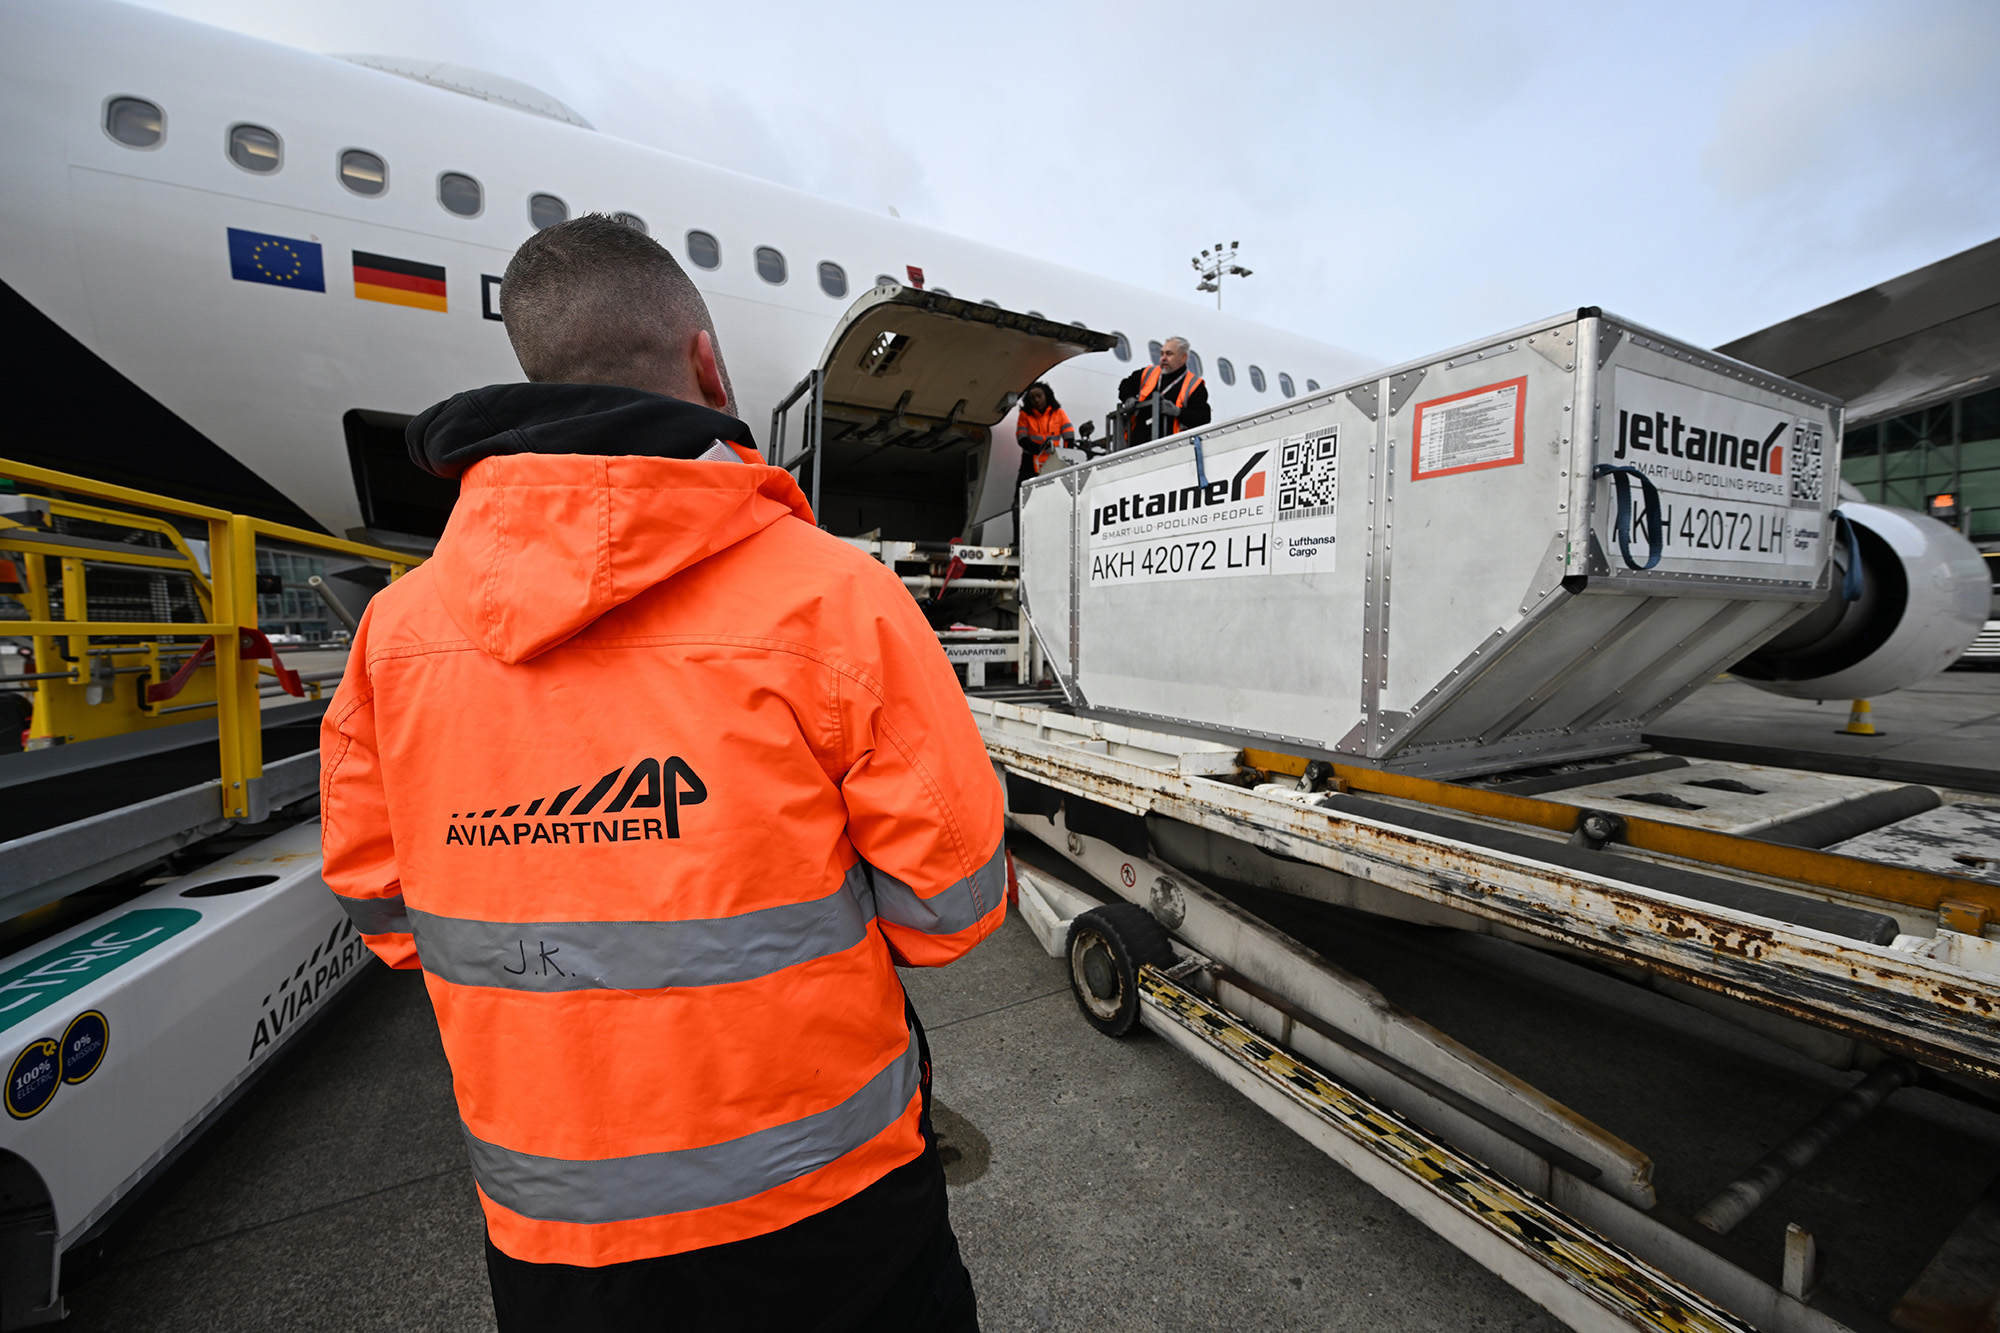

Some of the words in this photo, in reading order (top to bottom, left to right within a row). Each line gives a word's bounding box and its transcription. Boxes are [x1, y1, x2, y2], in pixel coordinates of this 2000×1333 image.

[1614, 409, 1789, 473] jettainer
[1090, 449, 1270, 535] jettainer
[1289, 535, 1336, 547] Lufthansa
[1680, 507, 1753, 551] 42072
[1758, 515, 1785, 553] LH
[1092, 550, 1134, 580] AKH
[1141, 540, 1217, 575] 42072
[1227, 533, 1266, 568] LH
[1289, 547, 1318, 557] Cargo
[947, 648, 1007, 657] AVIAPARTNER
[446, 818, 664, 846] AVIAPARTNER
[503, 939, 576, 977] J.K.
[249, 934, 370, 1062] AVIAPART
[67, 1040, 101, 1067] EMISSION
[74, 1034, 92, 1052] 0%
[16, 1060, 51, 1091] 100%
[17, 1070, 54, 1100] ELECTRIC
